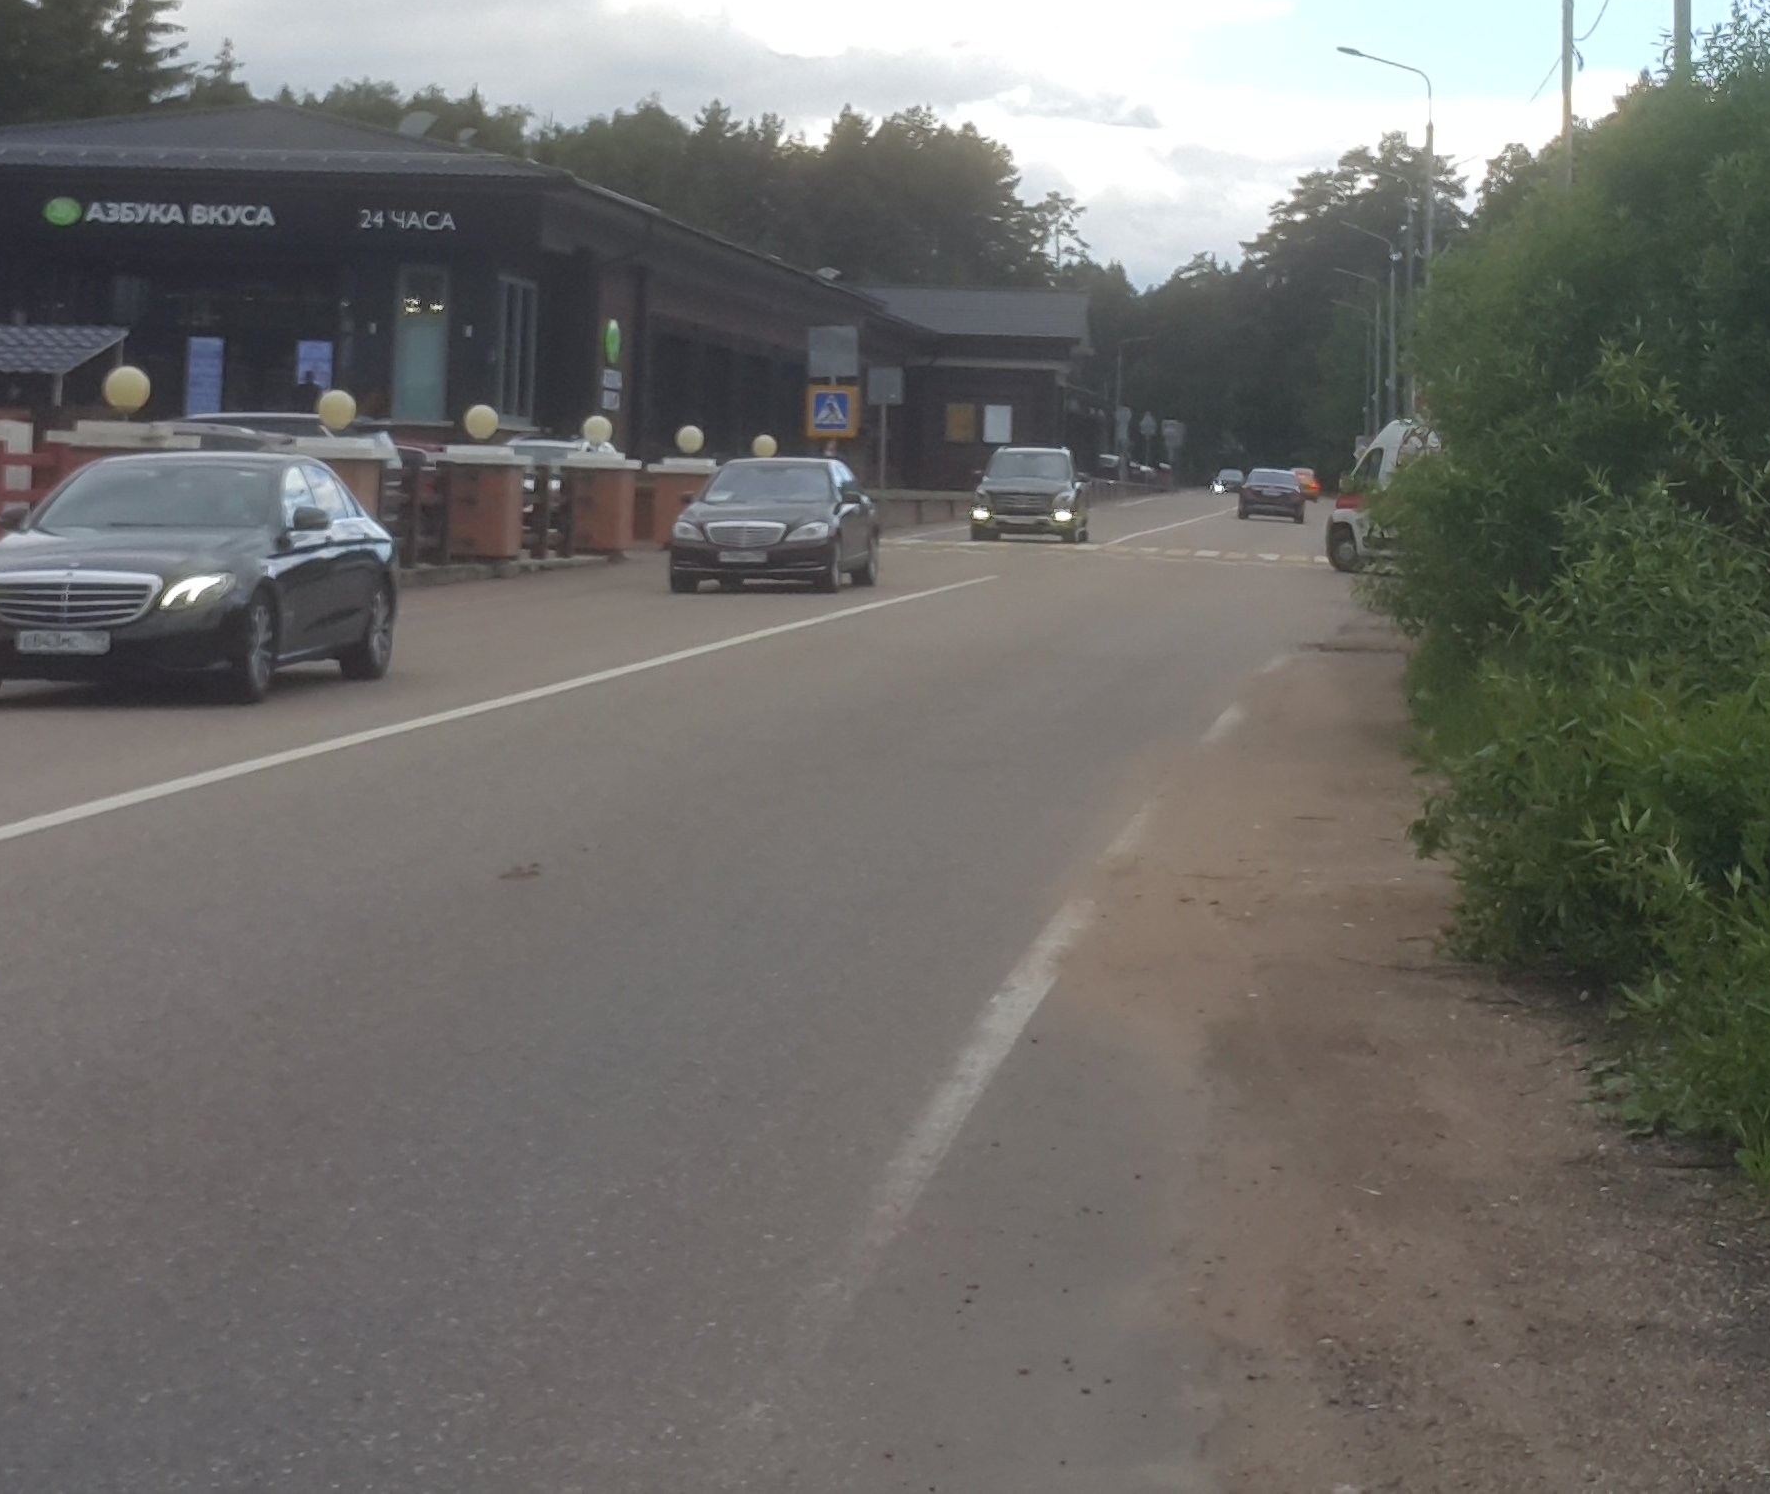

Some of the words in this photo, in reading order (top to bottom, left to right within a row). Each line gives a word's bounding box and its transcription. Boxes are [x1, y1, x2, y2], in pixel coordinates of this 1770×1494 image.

[84, 201, 185, 225] АЗБУКА
[190, 202, 276, 227] ВКУСА
[359, 209, 385, 230] 24
[388, 210, 457, 231] ЧАСА
